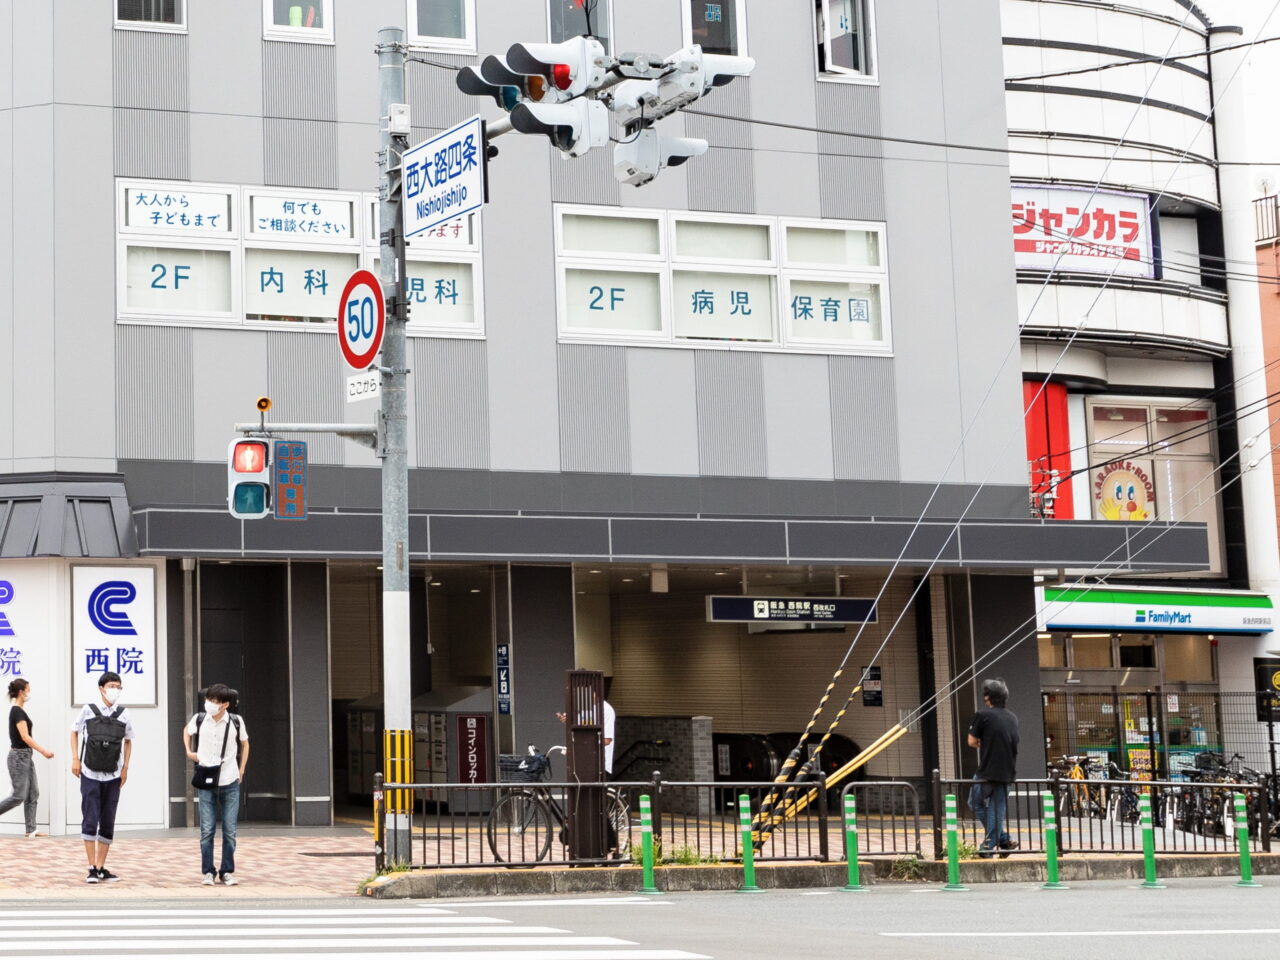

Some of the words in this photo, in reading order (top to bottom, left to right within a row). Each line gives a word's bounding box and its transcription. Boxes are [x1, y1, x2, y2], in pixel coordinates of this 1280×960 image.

[406, 133, 478, 199] 西大路四条
[135, 193, 190, 208] 大人から
[282, 200, 322, 216] 何でも
[416, 183, 467, 220] Nishiojishijo
[149, 211, 220, 228] 子どもまで
[258, 217, 346, 234] ご相談ください
[1011, 201, 1139, 243] ジャンカラ
[150, 263, 191, 290] 2F
[260, 267, 329, 296] 内科
[405, 277, 459, 305] 児科
[589, 285, 626, 311] 2F
[691, 289, 752, 316] 病児
[347, 296, 374, 343] 50
[791, 295, 870, 323] 保育園
[348, 378, 378, 397] ここから
[1148, 610, 1192, 624] FamilyMart
[85, 647, 144, 675] 西院
